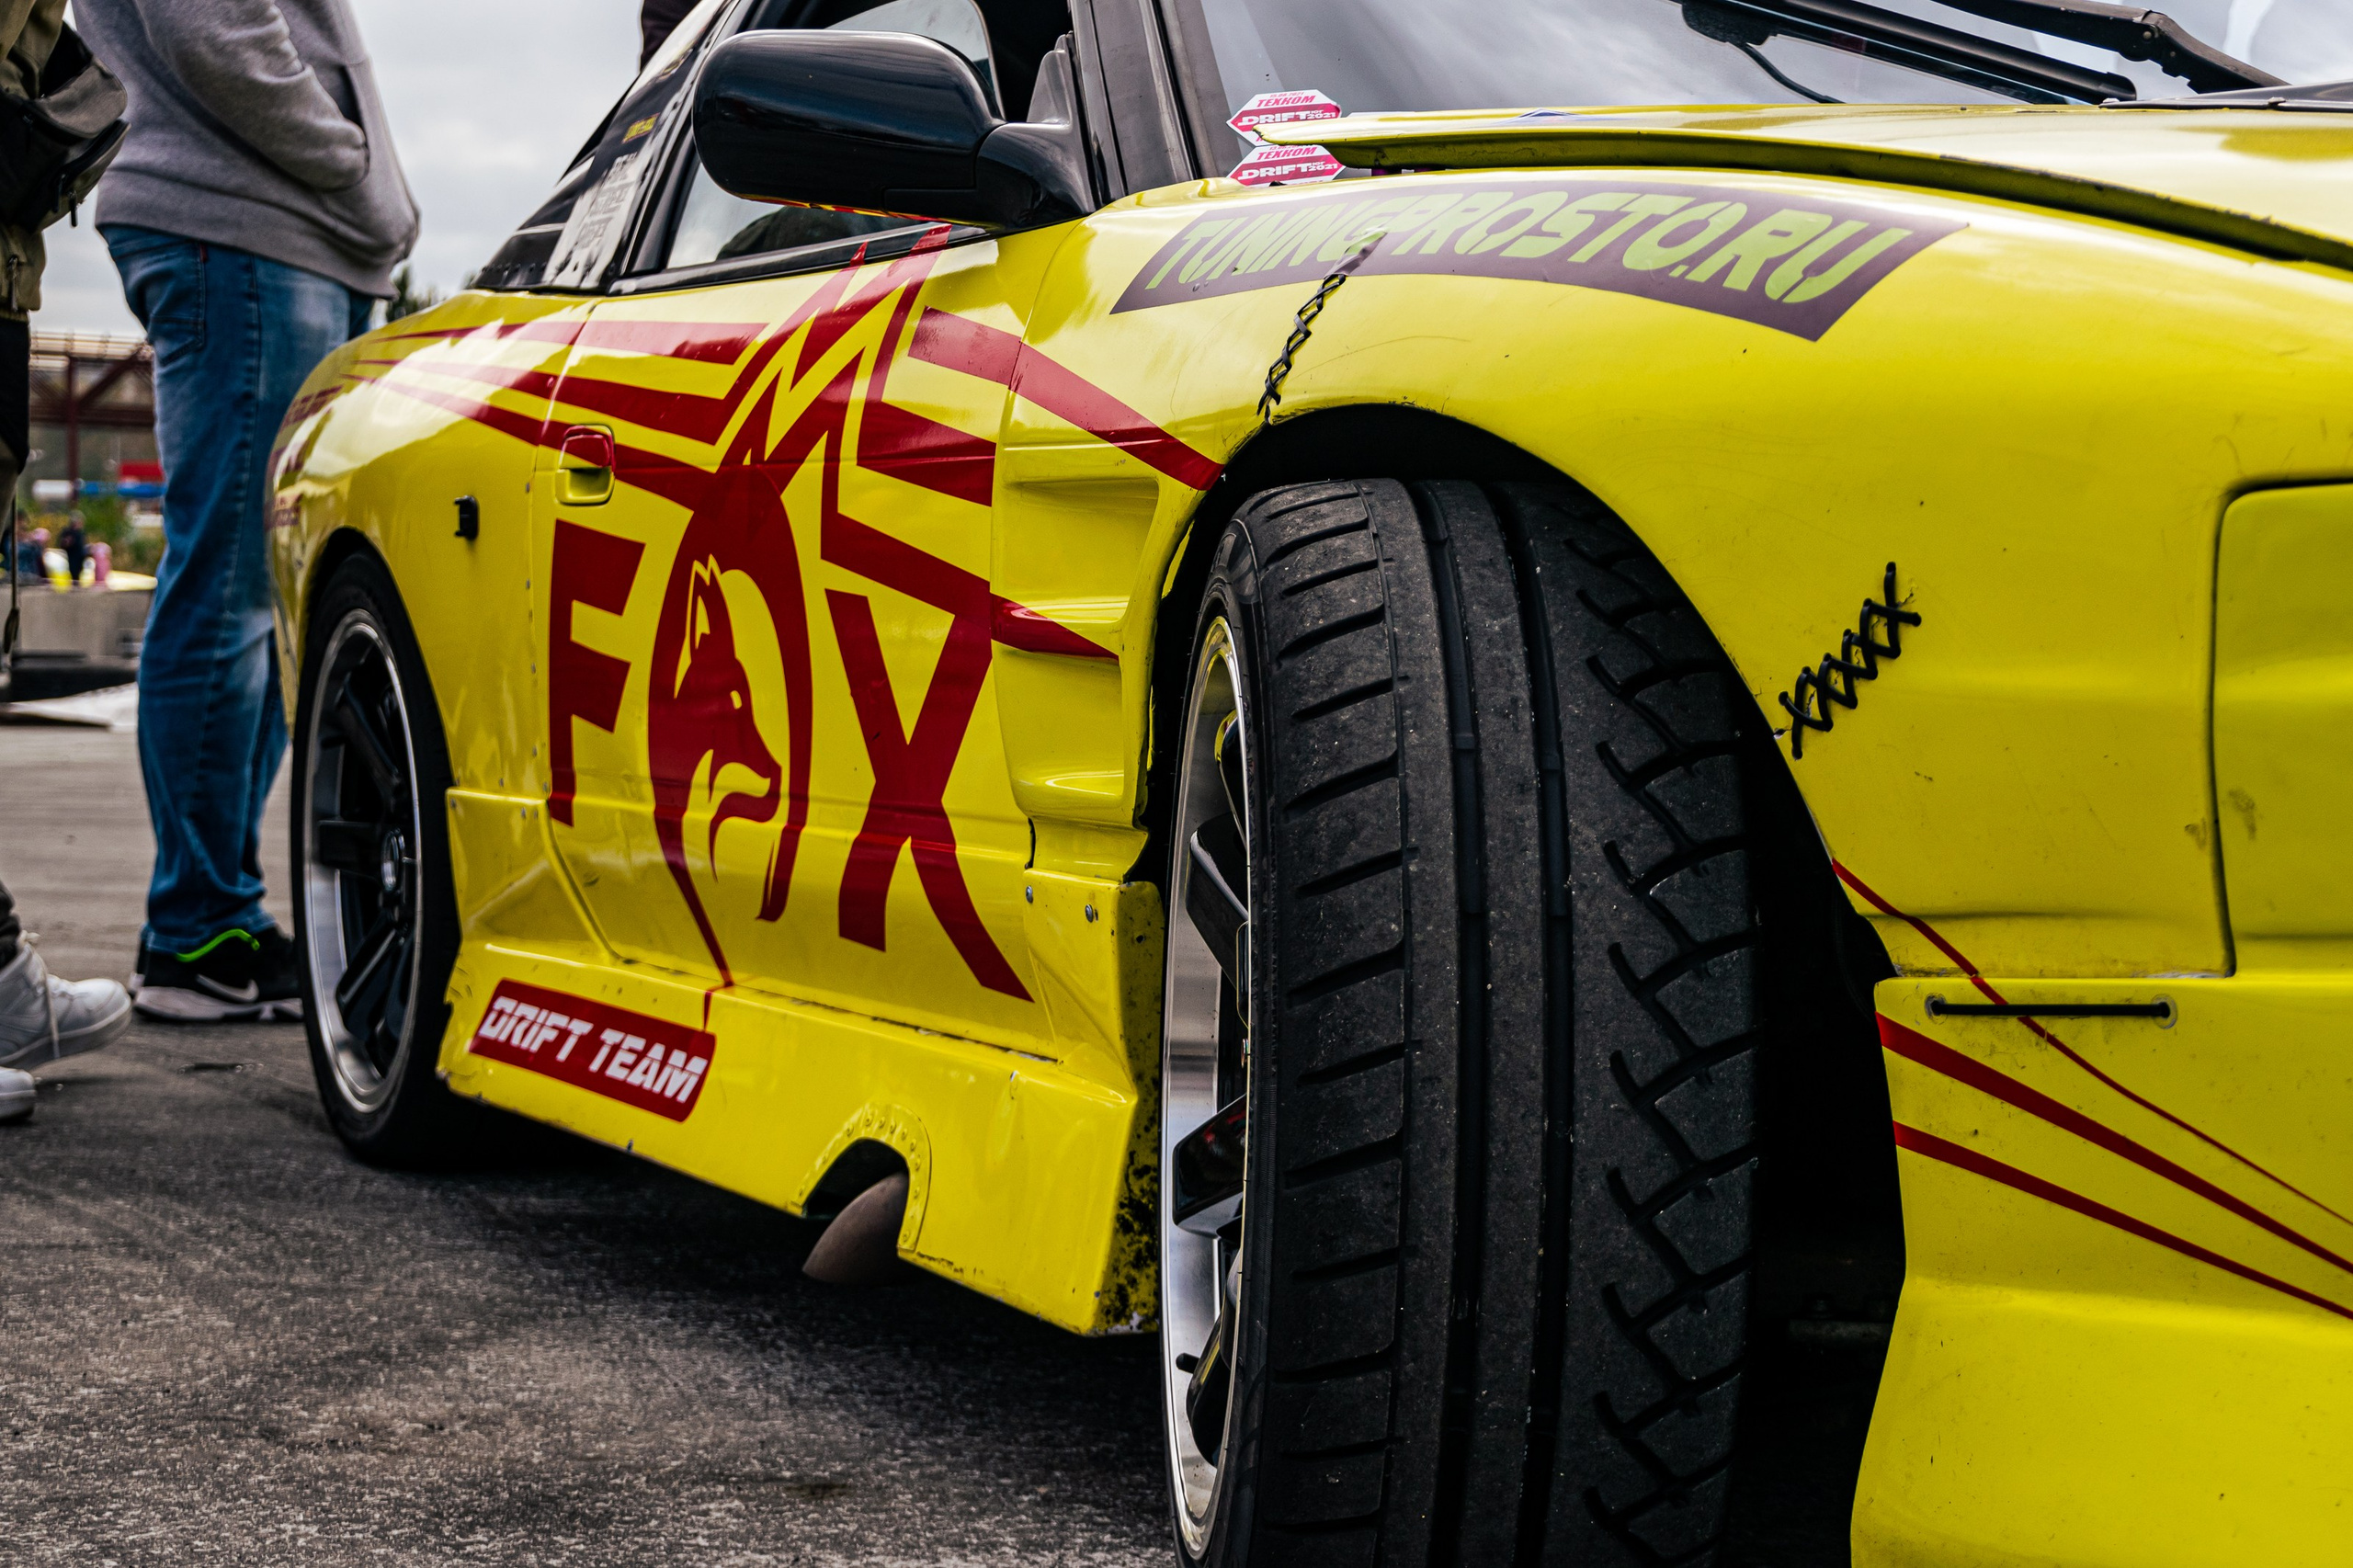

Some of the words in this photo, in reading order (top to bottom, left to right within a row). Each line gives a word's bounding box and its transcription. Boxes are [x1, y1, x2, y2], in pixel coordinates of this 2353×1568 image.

[1237, 110, 1311, 126] DRIFT
[1237, 163, 1312, 180] DRIFT
[1308, 163, 1338, 172] 2021
[548, 464, 1036, 1004] FOX
[479, 995, 594, 1062] DRIFT
[588, 1028, 709, 1103] TEAM
